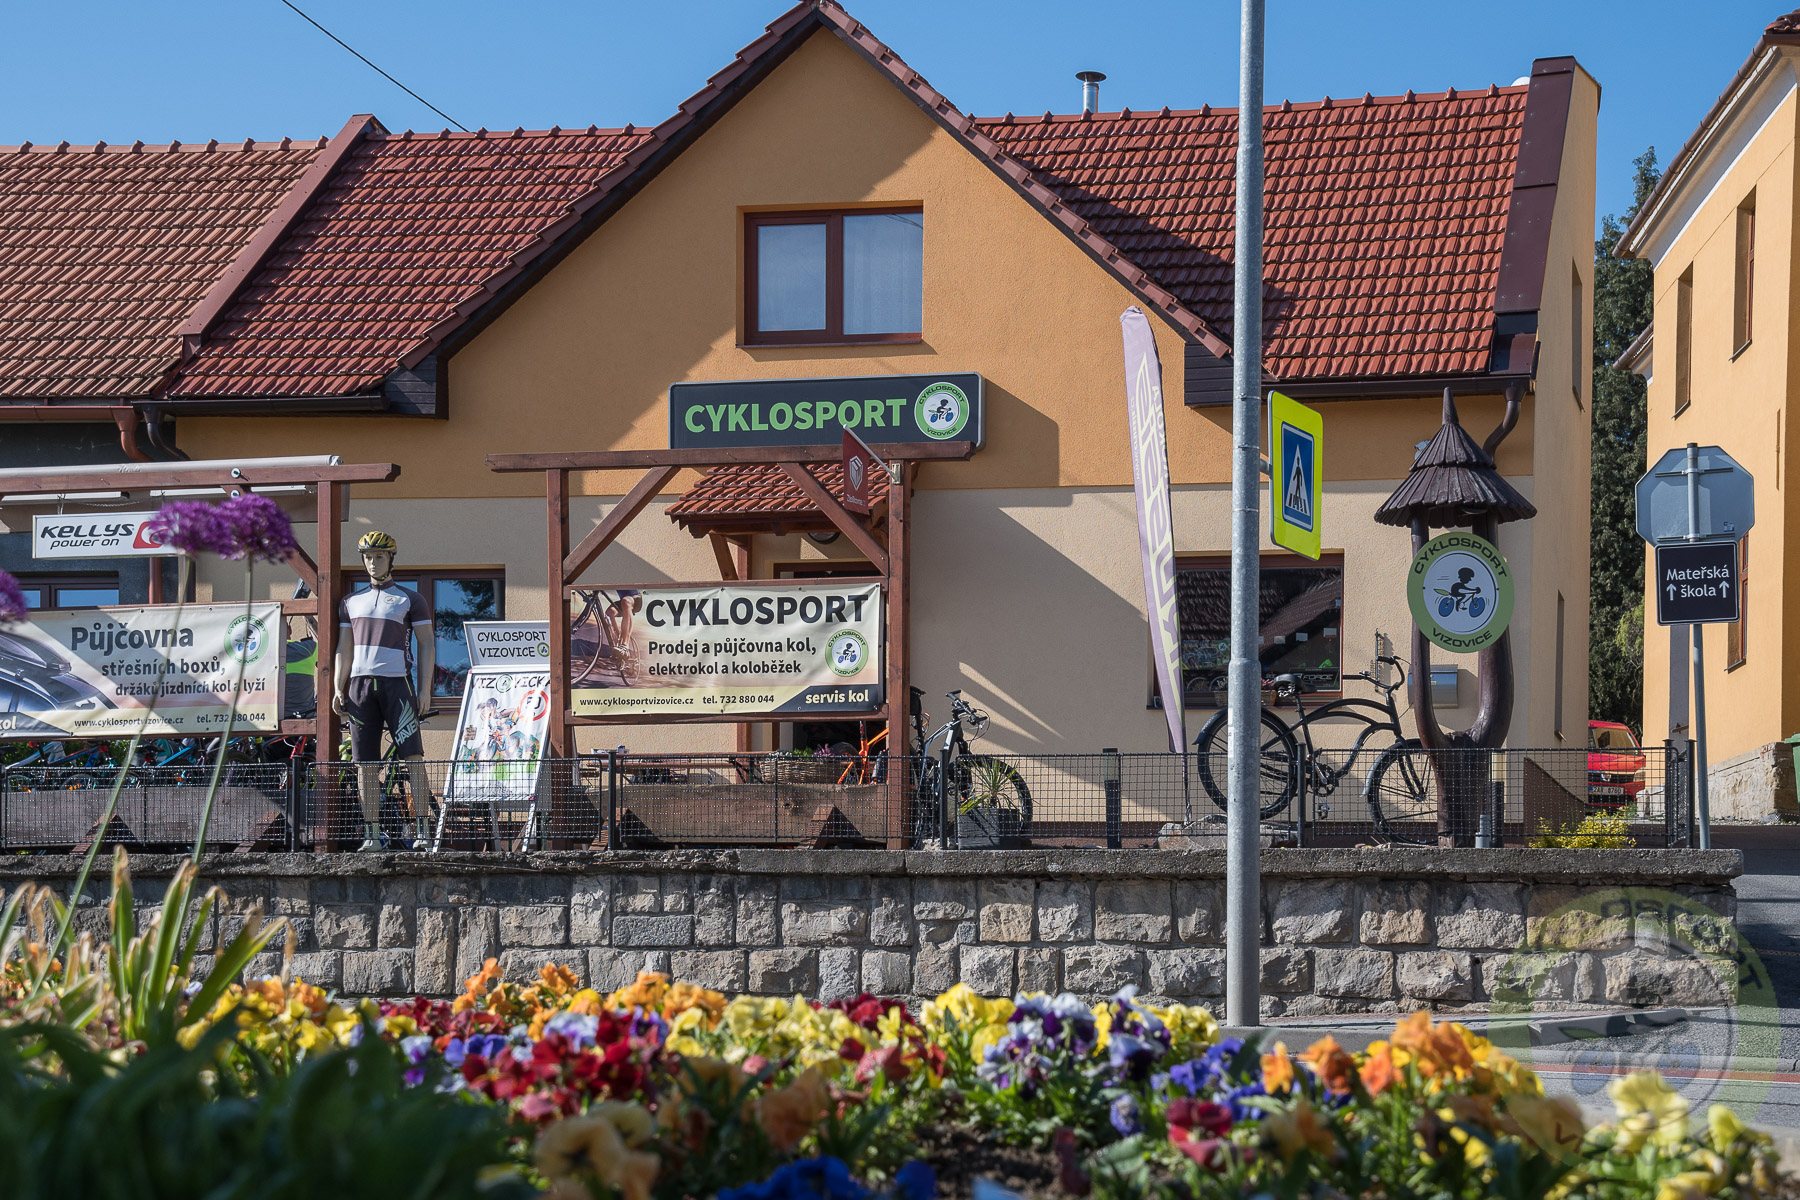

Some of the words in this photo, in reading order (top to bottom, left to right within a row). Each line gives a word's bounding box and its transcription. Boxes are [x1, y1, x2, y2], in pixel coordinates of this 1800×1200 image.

[918, 385, 965, 405] CYKLOSPORT
[684, 398, 907, 433] CYKLOSPORT
[927, 427, 957, 437] VIZOVICE
[50, 540, 99, 550] power
[101, 538, 120, 547] on
[1414, 537, 1508, 578] CYKLOSPORT
[1666, 564, 1730, 581] Mateřská
[1680, 583, 1717, 598] škola
[645, 594, 869, 628] CYKLOSPORT
[71, 621, 194, 656] Půjčovna
[477, 631, 547, 642] CYKLOSPORT
[827, 630, 866, 648] CYKLOSPORT
[1432, 627, 1493, 648] VIZOVICE
[479, 646, 536, 658] VIZOVICE
[648, 638, 699, 656] Prodej
[701, 643, 710, 654] a
[713, 636, 783, 657] půjčovna
[786, 637, 817, 656] kol,
[101, 658, 176, 677] střešních
[180, 655, 226, 676] boxů,
[648, 661, 719, 676] elektrokol
[720, 663, 728, 674] a
[731, 660, 802, 675] koloběžek
[115, 681, 159, 697] držáků
[160, 680, 209, 697] jízdních
[212, 680, 231, 693] kol
[243, 678, 266, 694] lyží
[805, 690, 846, 704] servis
[848, 689, 869, 703] kol
[579, 695, 694, 707] www.cyklosportvizovice.cz
[702, 695, 718, 704] tel.
[720, 695, 737, 704] 732
[738, 695, 755, 704] 880
[757, 694, 775, 703] 044
[196, 714, 211, 724] tel.
[213, 714, 229, 723] 732
[249, 712, 266, 722] 044
[394, 718, 419, 746] HAVE
